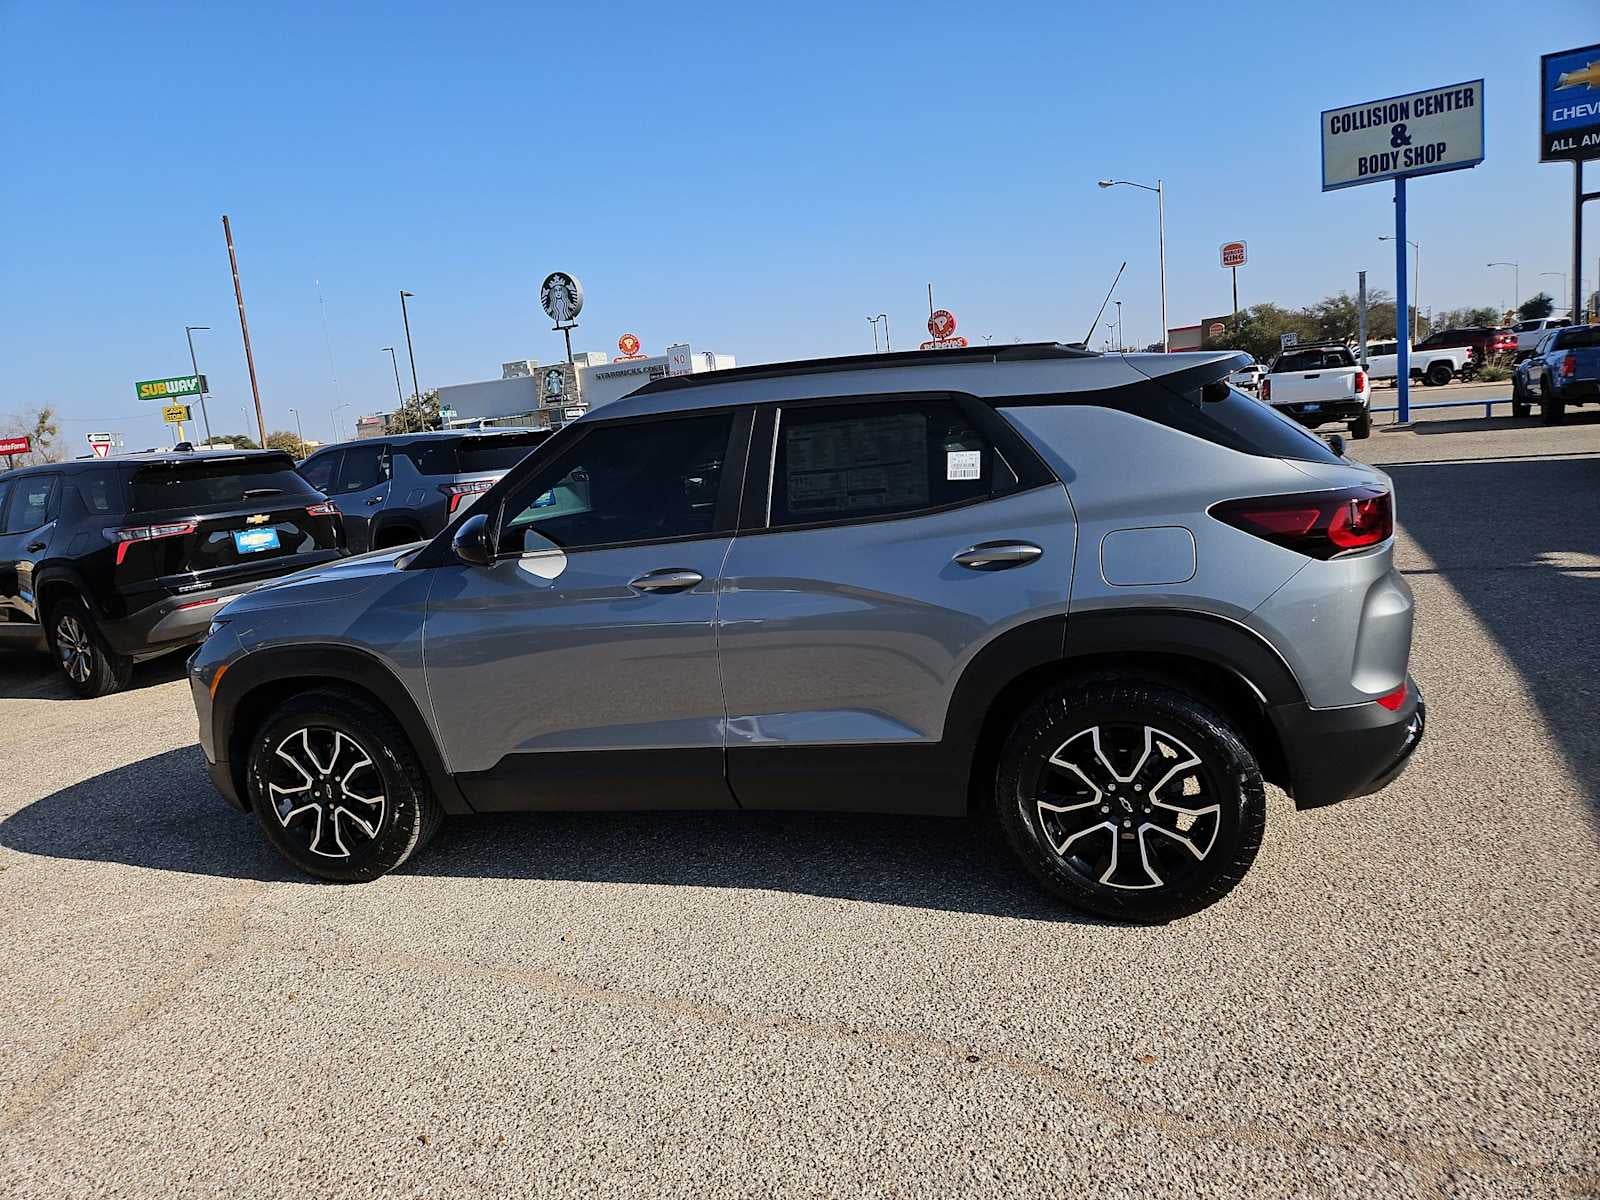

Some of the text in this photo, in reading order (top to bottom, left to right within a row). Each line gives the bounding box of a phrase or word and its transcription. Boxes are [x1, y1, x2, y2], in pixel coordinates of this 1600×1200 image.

[1330, 87, 1475, 135] COLLISION CENTER
[1552, 101, 1600, 121] CHEV
[1390, 123, 1412, 148] &
[1551, 138, 1577, 152] ALL
[1358, 142, 1447, 176] BODY SHOP
[1223, 254, 1244, 262] KING
[673, 354, 685, 365] NO
[594, 367, 642, 380] STARBUCKS
[140, 378, 198, 397] SUBWAY
